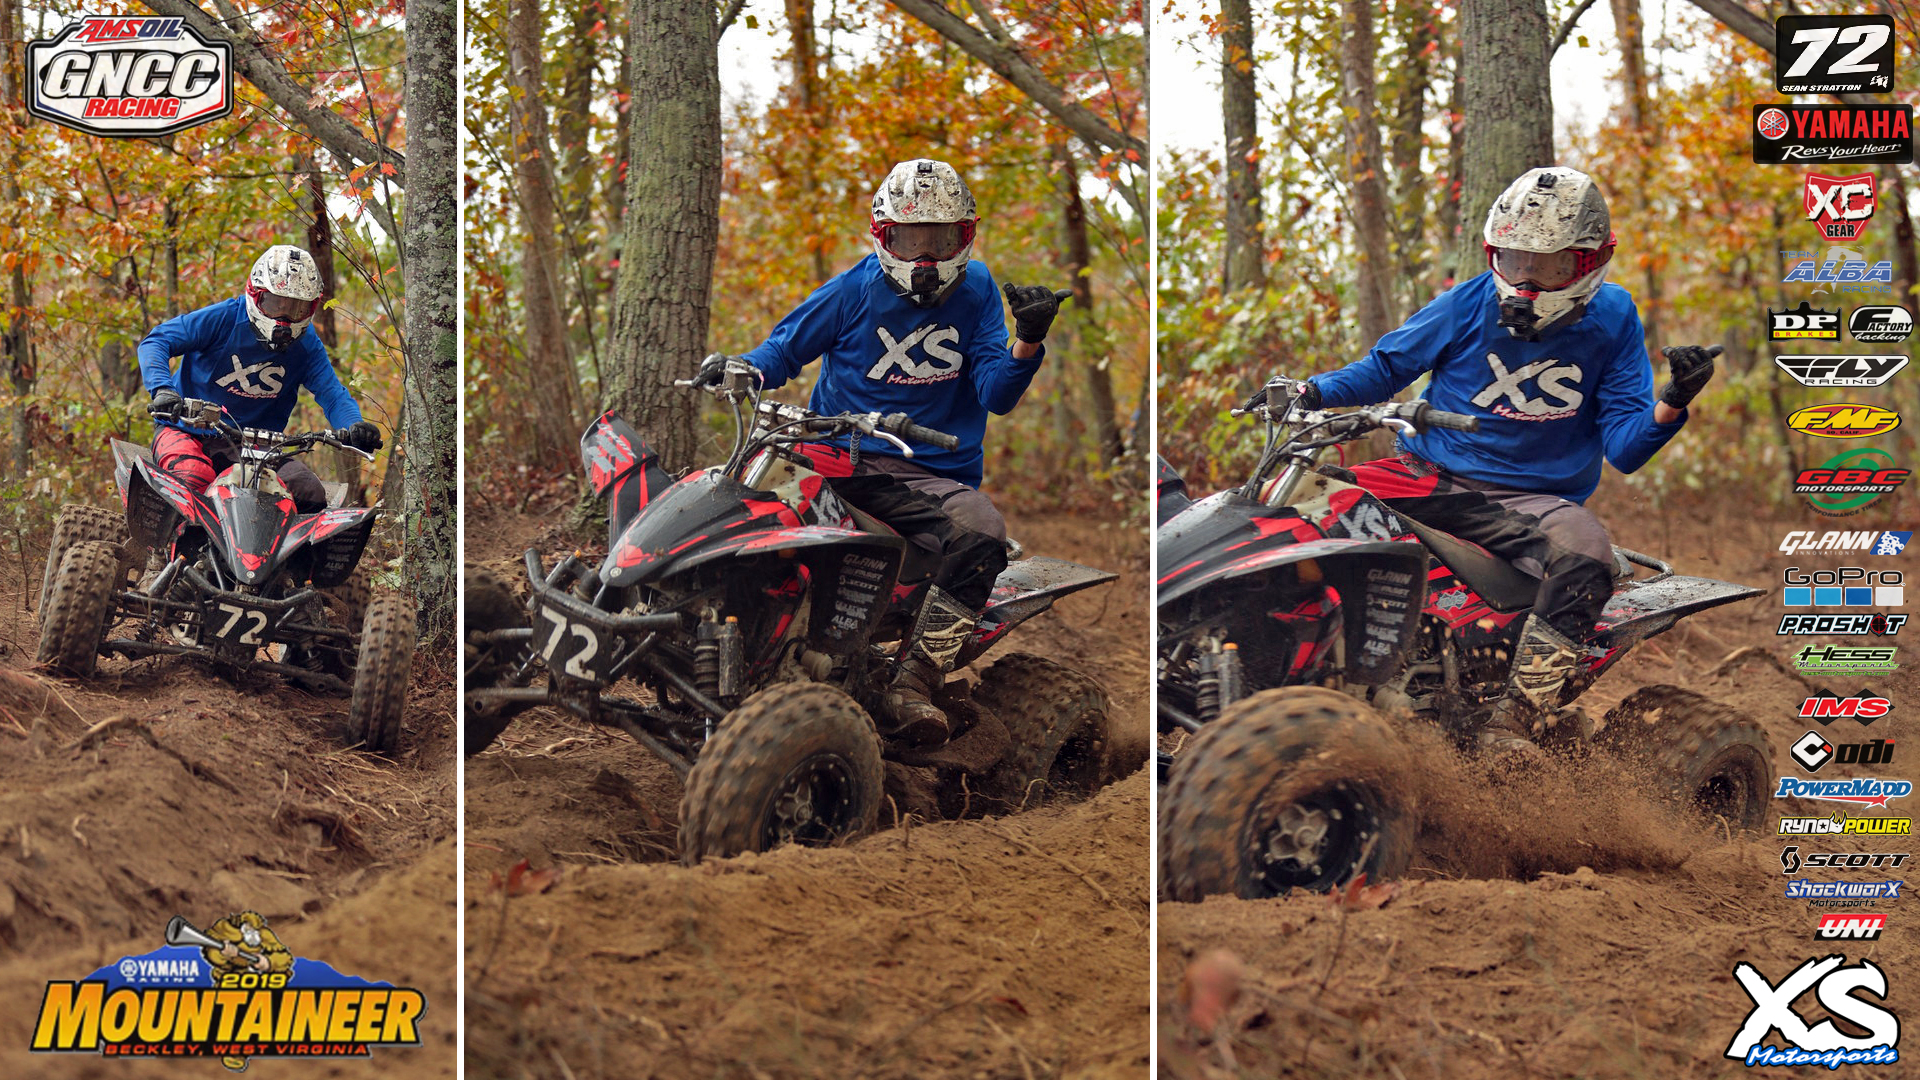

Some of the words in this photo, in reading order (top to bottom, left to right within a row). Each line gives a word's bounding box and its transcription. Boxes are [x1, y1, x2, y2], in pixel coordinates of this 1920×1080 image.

[215, 354, 285, 395] XS
[867, 323, 963, 380] XS
[1471, 352, 1584, 415] XS
[216, 603, 268, 645] 72
[541, 605, 599, 681] 72
